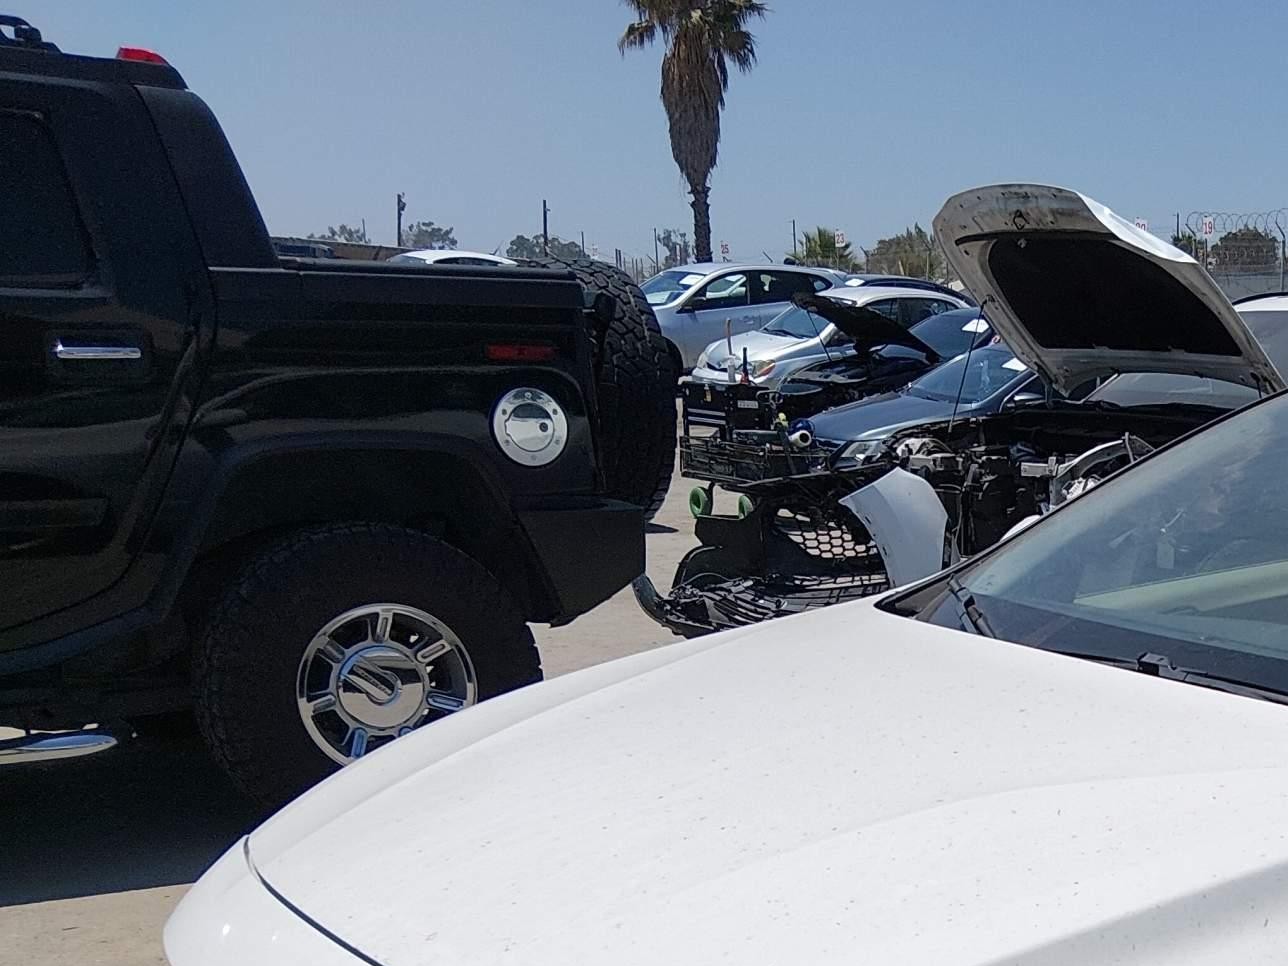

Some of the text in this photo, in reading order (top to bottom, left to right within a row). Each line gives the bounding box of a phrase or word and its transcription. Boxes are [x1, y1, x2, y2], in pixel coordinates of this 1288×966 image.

[1203, 221, 1213, 235] 19
[835, 232, 845, 245] 23
[720, 243, 730, 255] 25
